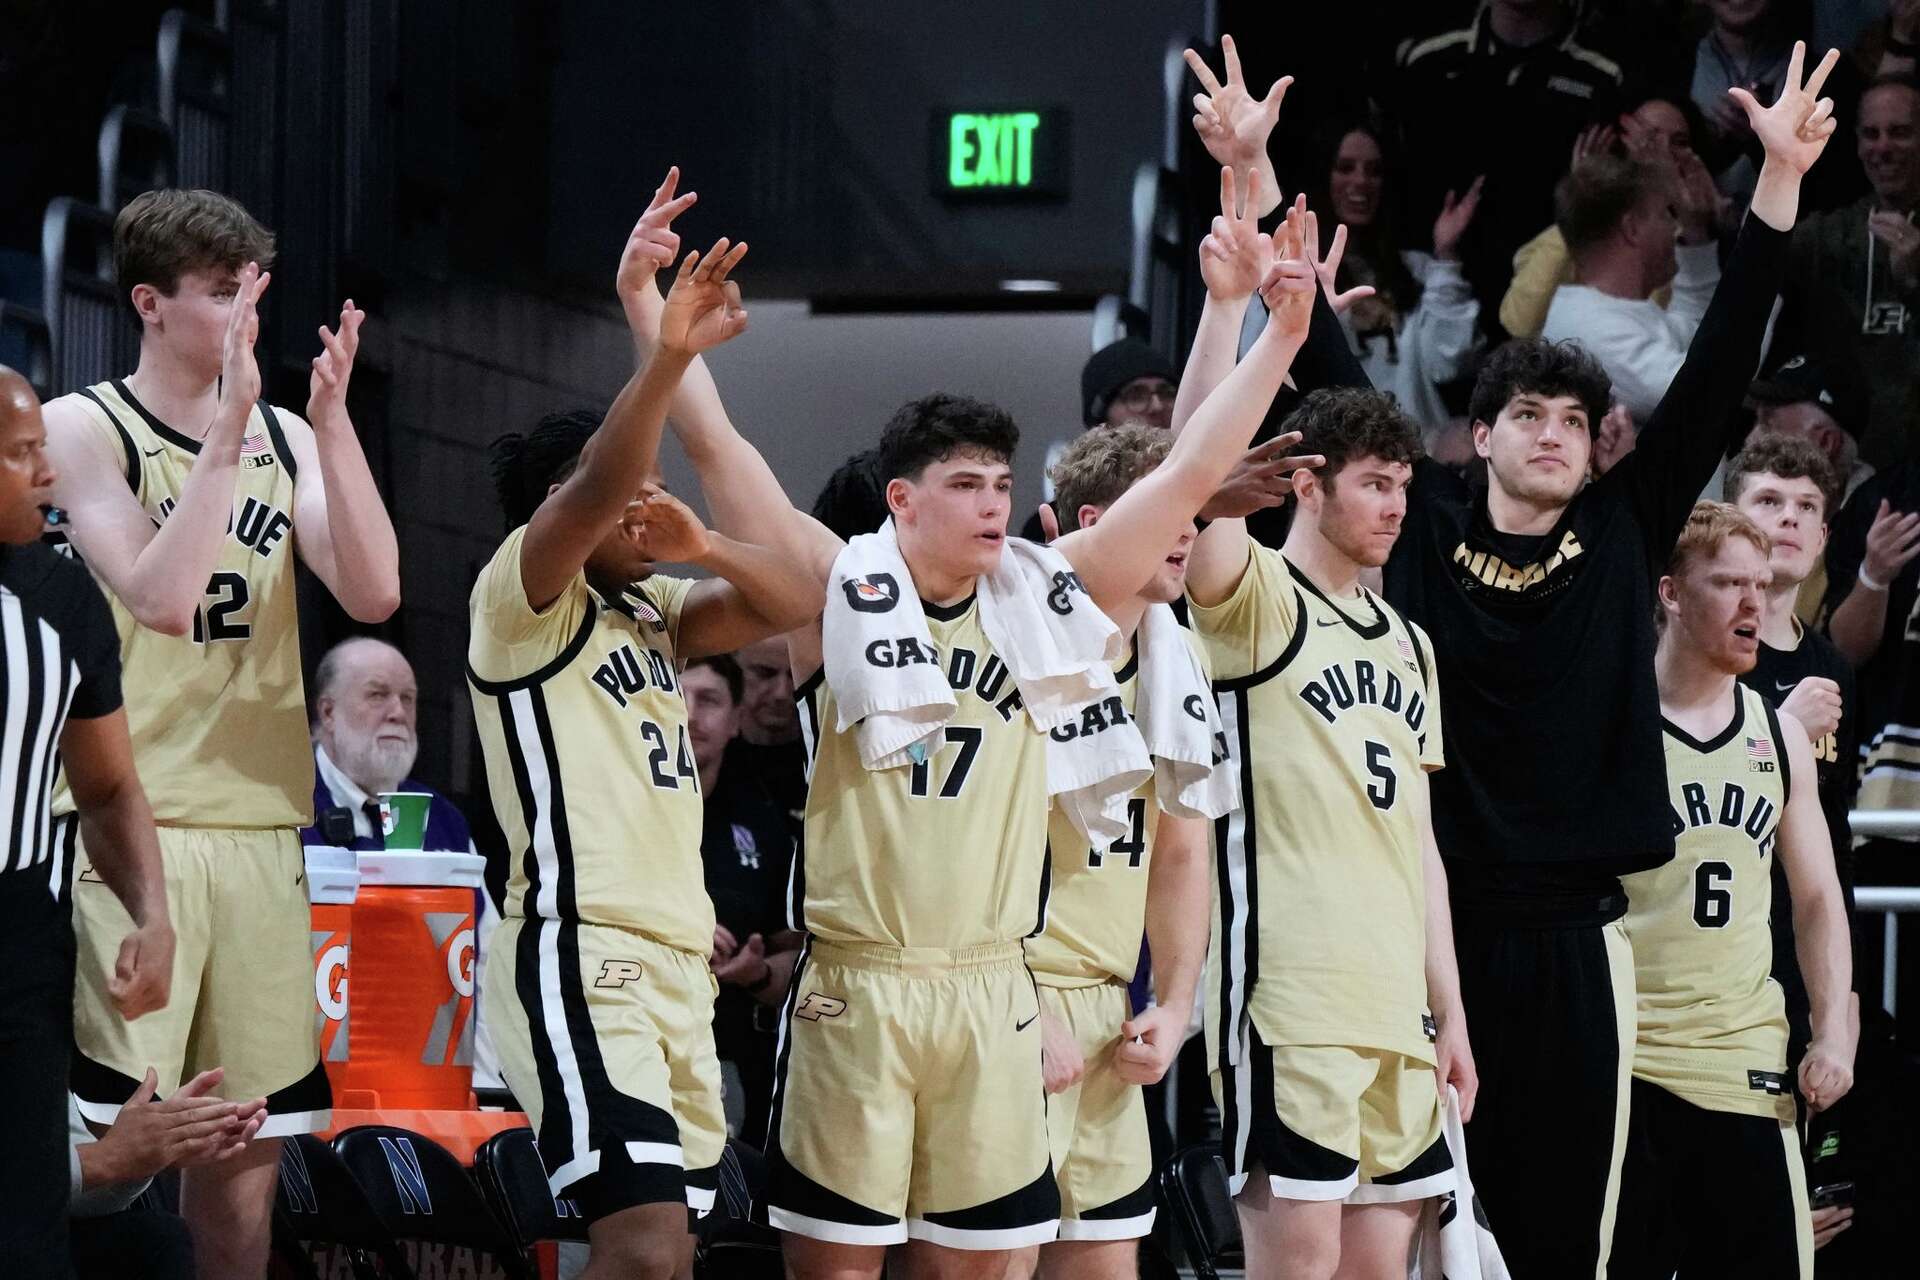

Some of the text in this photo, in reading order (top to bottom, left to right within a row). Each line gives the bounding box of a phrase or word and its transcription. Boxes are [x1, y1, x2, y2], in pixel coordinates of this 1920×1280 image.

[949, 112, 1040, 187] EXIT
[639, 719, 699, 795] 24
[1364, 738, 1398, 812] 5
[1692, 861, 1733, 929] 6
[315, 944, 348, 1022] G
[594, 960, 642, 988] P
[795, 992, 847, 1021] P
[376, 1137, 433, 1215] N
